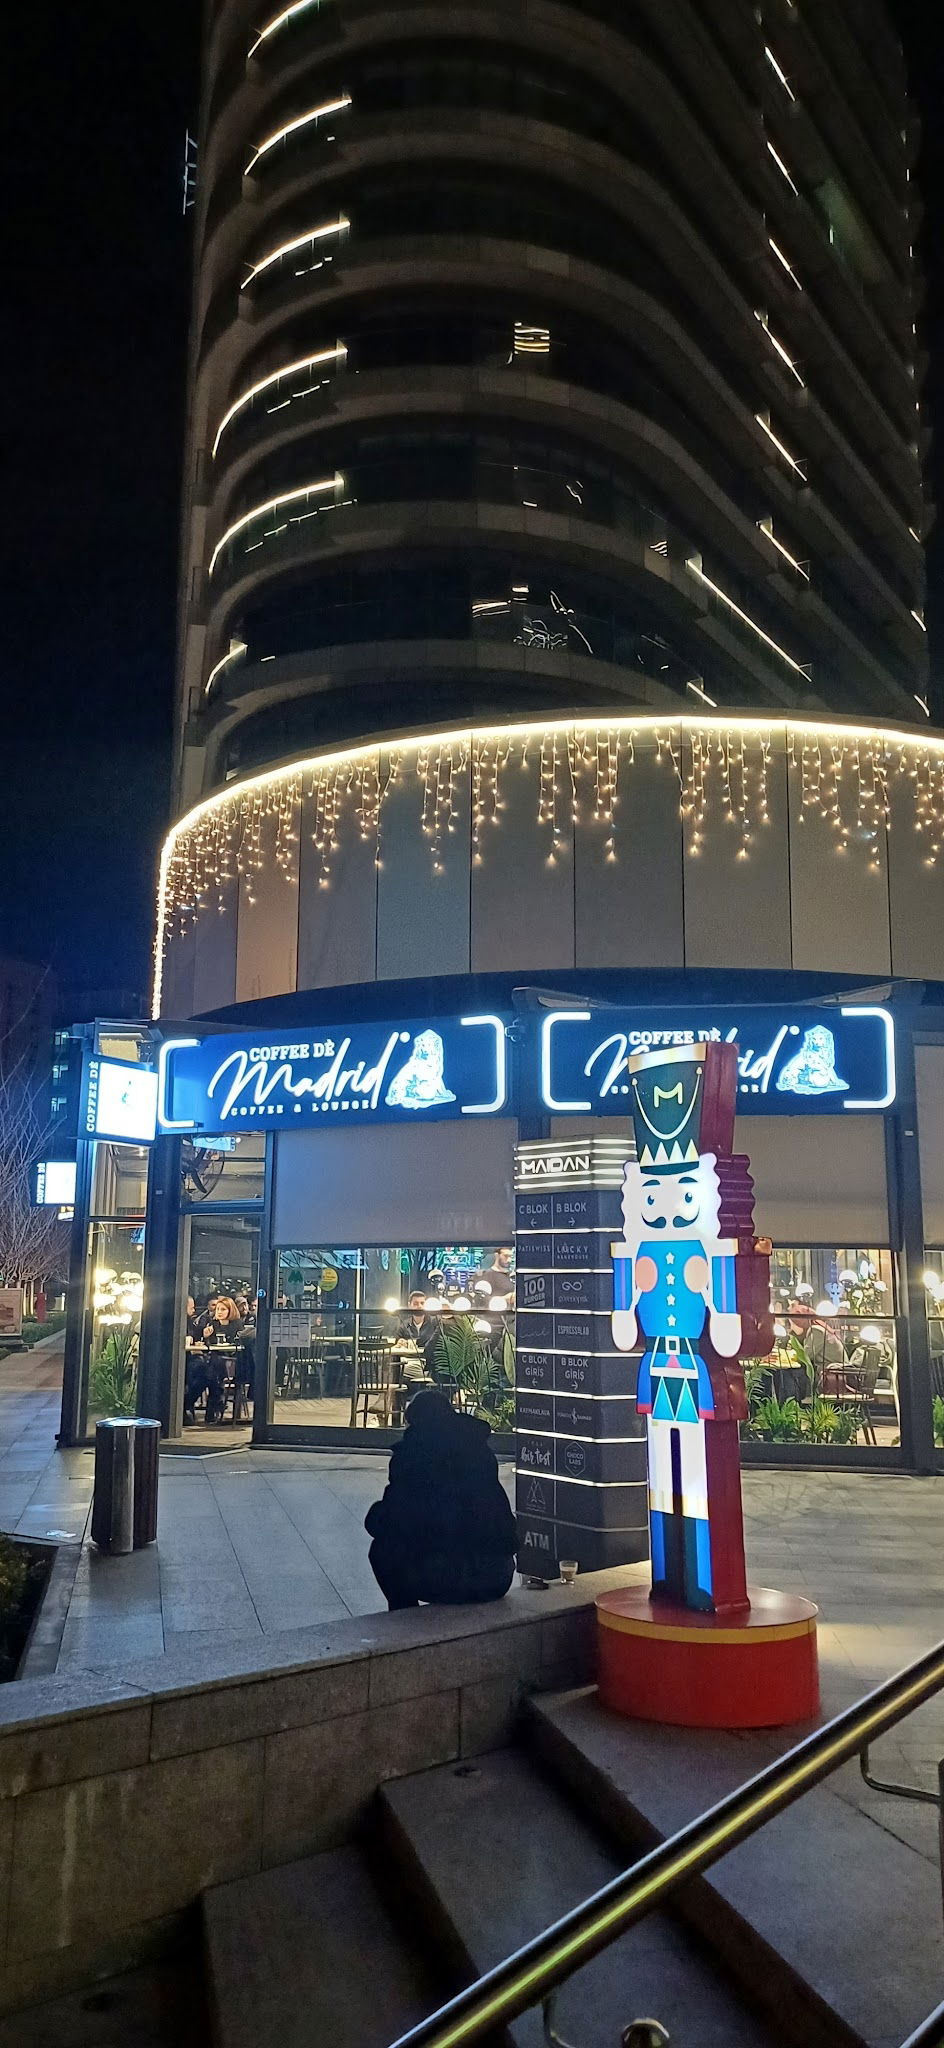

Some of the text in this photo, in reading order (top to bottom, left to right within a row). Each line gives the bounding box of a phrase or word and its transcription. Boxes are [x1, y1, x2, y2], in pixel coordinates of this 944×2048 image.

[629, 1031, 694, 1045] COFFEE
[249, 1045, 310, 1063] COFFEE
[207, 1031, 400, 1120] Madrid
[653, 1081, 683, 1108] M
[86, 1080, 98, 1132] COFFEE
[230, 1104, 285, 1117] COFFEE
[312, 1099, 372, 1112] LOUNGE
[521, 1155, 590, 1174] MAIDAN
[519, 1204, 549, 1214] C BLOK
[556, 1202, 587, 1213] B BLOK
[523, 1277, 546, 1297] 100
[521, 1354, 548, 1364] C BLOK
[561, 1357, 589, 1368] B BLOK
[524, 1530, 550, 1550] ATM
